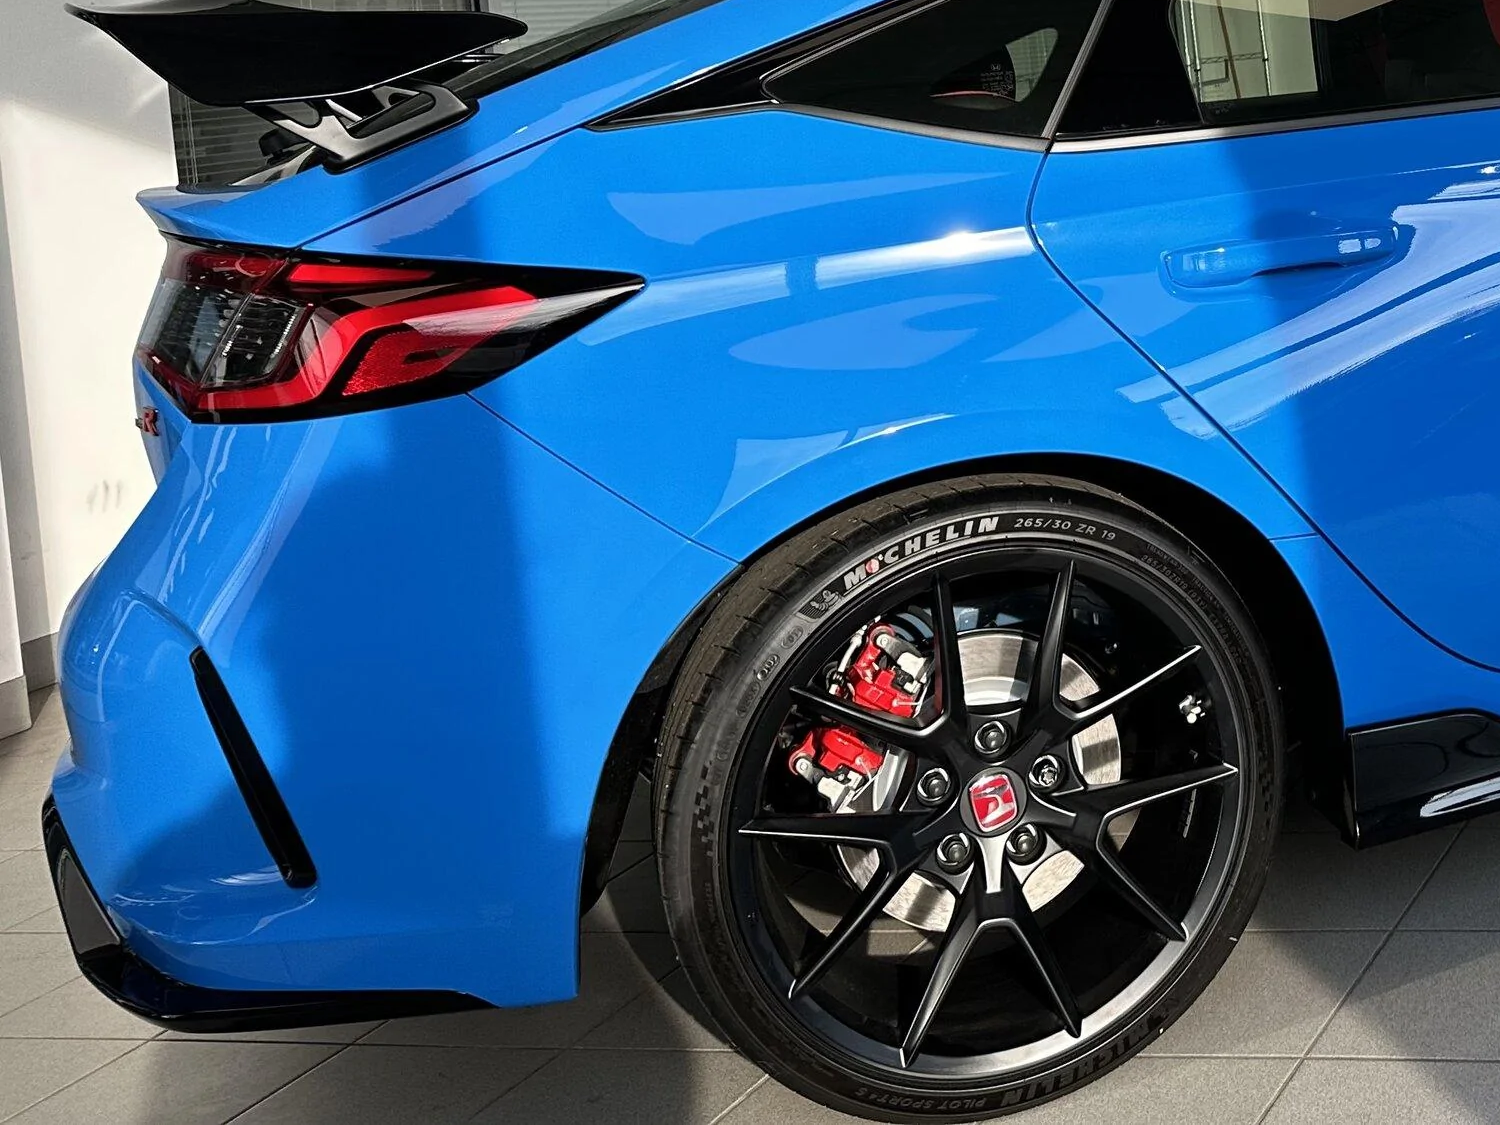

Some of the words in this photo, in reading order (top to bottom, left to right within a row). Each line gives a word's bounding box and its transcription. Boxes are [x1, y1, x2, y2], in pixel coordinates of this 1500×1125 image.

[843, 516, 1000, 591] MCHELIN
[1014, 517, 1070, 530] 265/30
[1075, 523, 1099, 536] ZR
[1101, 529, 1117, 542] 19
[937, 1095, 987, 1111] PILOT
